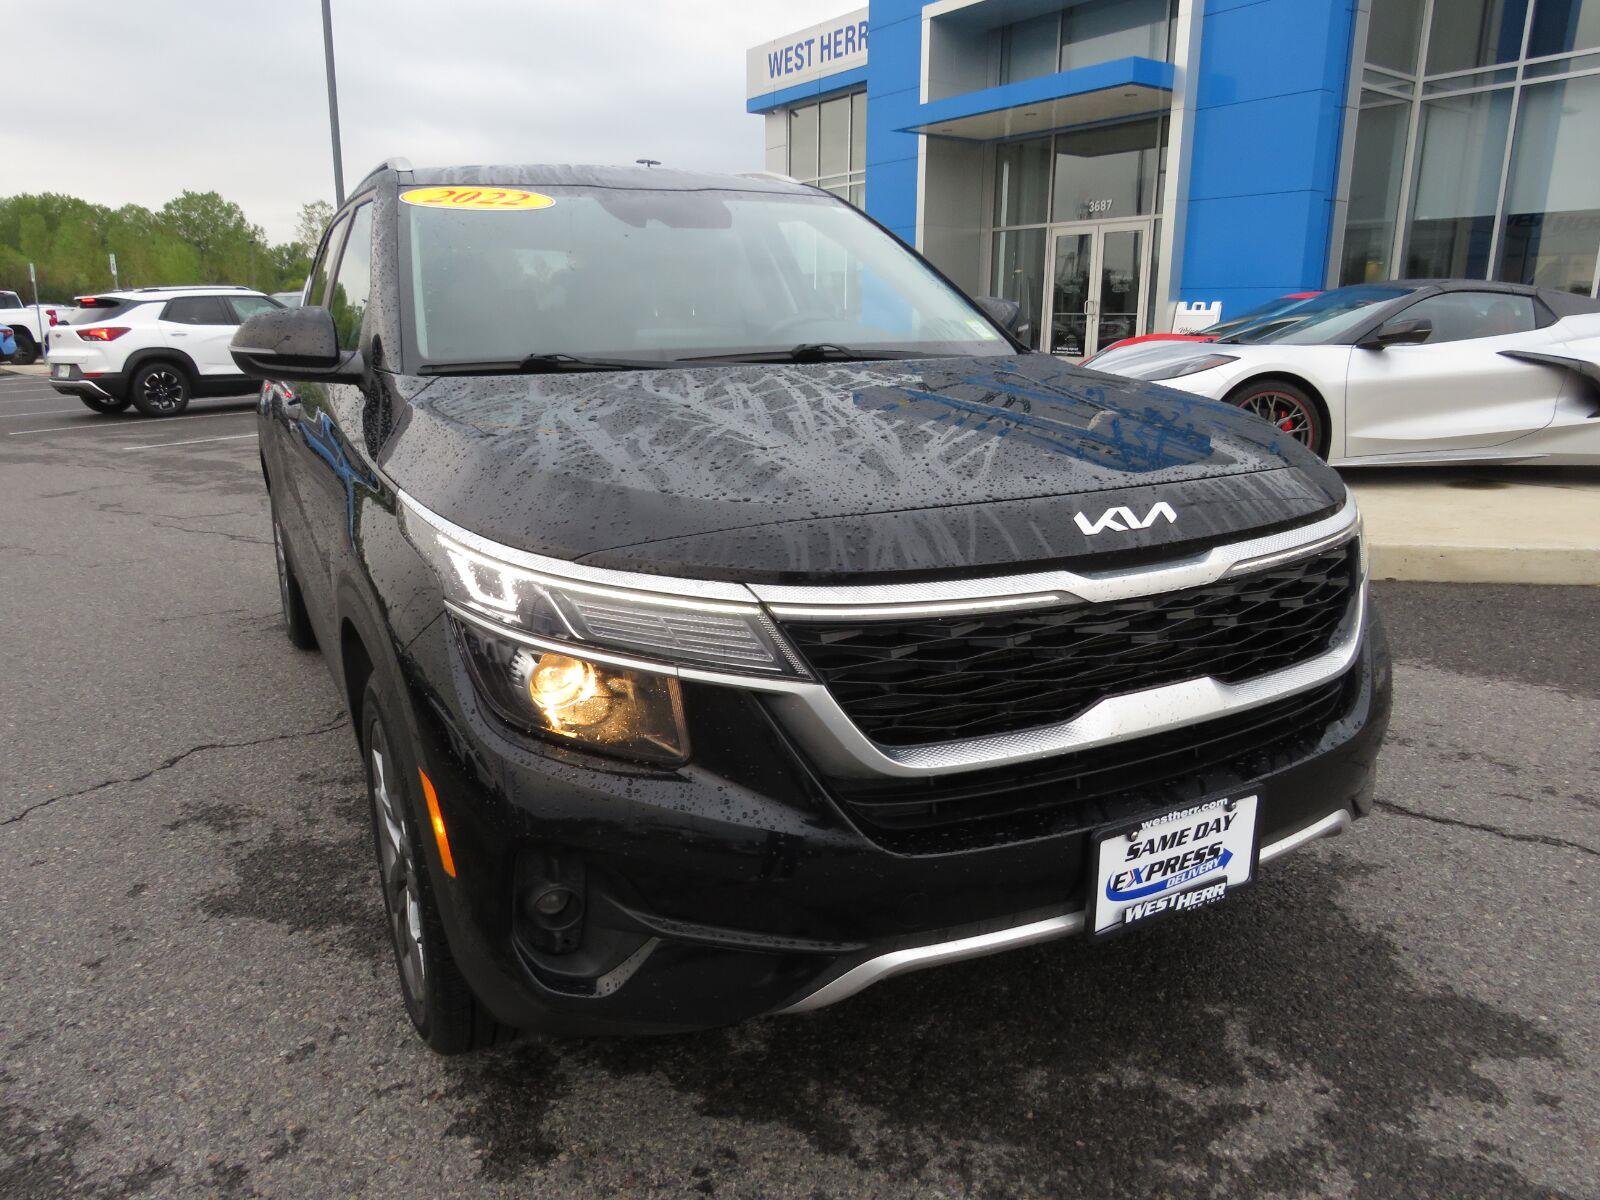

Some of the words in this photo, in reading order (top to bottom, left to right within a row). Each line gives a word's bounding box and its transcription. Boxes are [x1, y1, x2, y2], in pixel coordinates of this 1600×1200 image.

[768, 39, 815, 79] WEST
[820, 20, 869, 63] HERR
[423, 190, 530, 206] 2022
[1088, 198, 1113, 212] 3687
[1125, 827, 1192, 862] SAME
[1192, 812, 1238, 842] DAY
[1112, 841, 1223, 892] EXPRESS
[1166, 856, 1223, 889] DELIVERY
